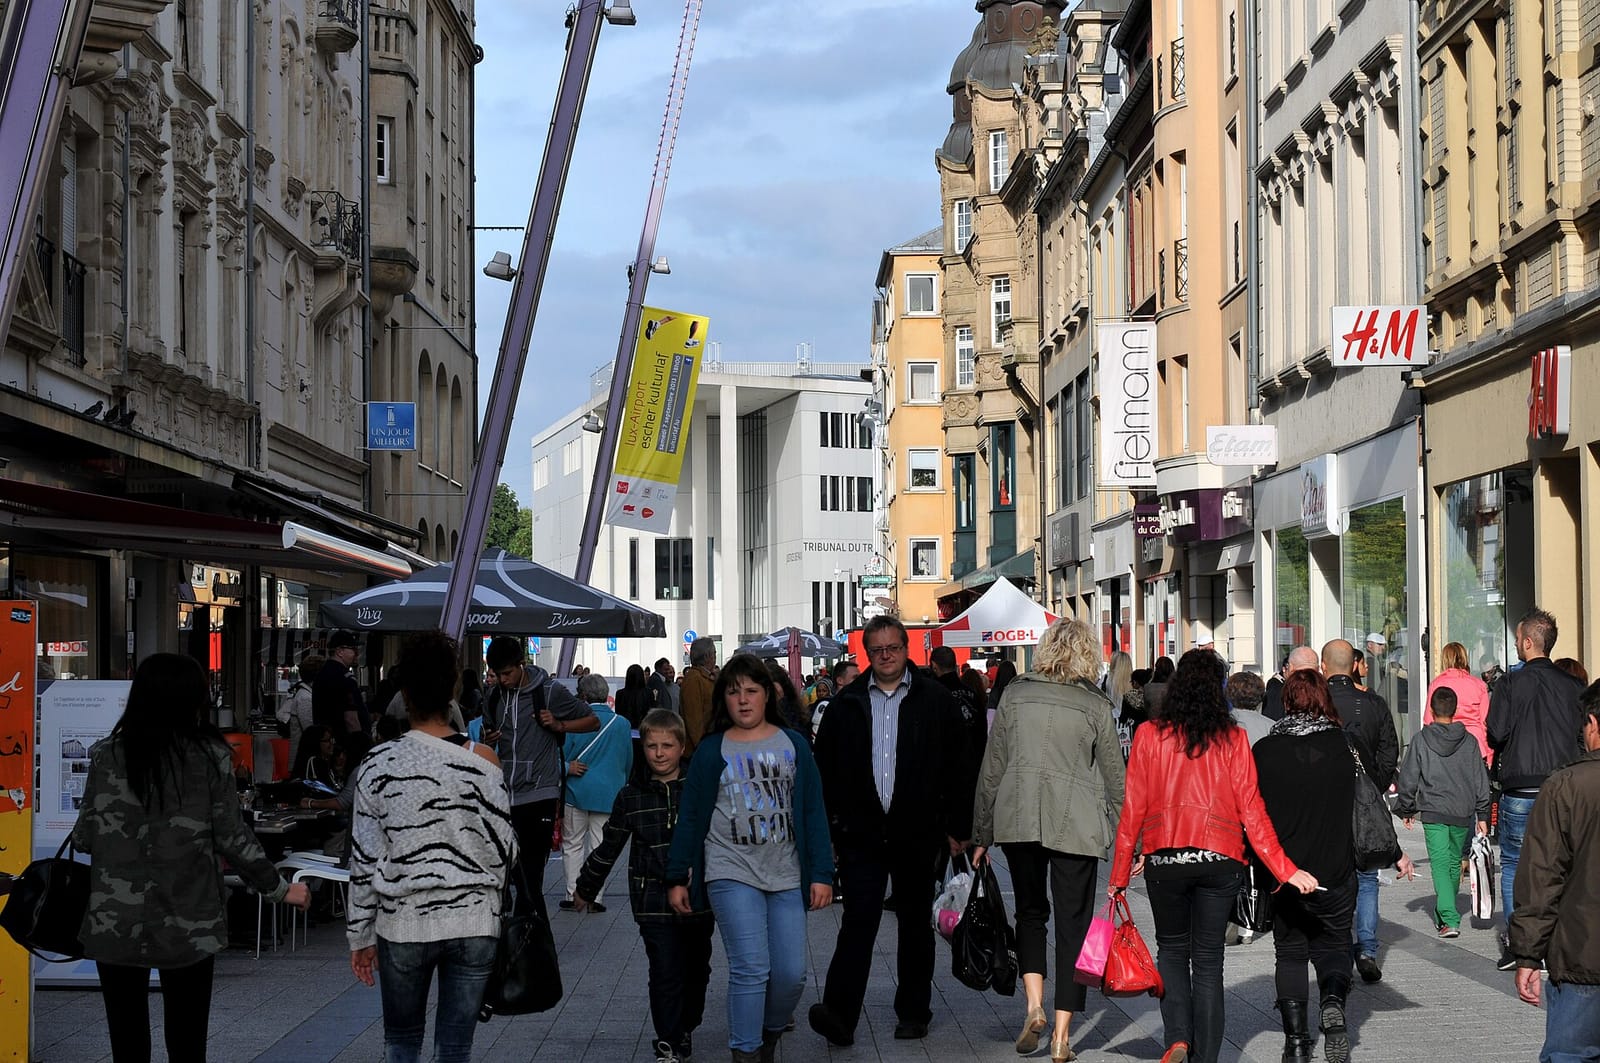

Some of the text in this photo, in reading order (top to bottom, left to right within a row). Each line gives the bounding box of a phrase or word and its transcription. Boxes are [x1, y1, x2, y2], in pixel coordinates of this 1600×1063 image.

[1342, 308, 1419, 361] H&M
[642, 351, 669, 449] escher kulturlaf
[1113, 328, 1152, 479] fielmann
[624, 381, 648, 447] lux-Airport
[659, 429, 667, 450] samedi
[664, 392, 675, 423] septembre
[371, 427, 410, 437] UN JOUR
[373, 437, 410, 446] AILLEURS
[1208, 433, 1272, 453] Etam
[1138, 525, 1148, 534] du
[803, 542, 846, 552] TRIBUNAL
[848, 543, 861, 552] DU
[356, 607, 382, 620] Viva
[547, 612, 591, 629] Blue
